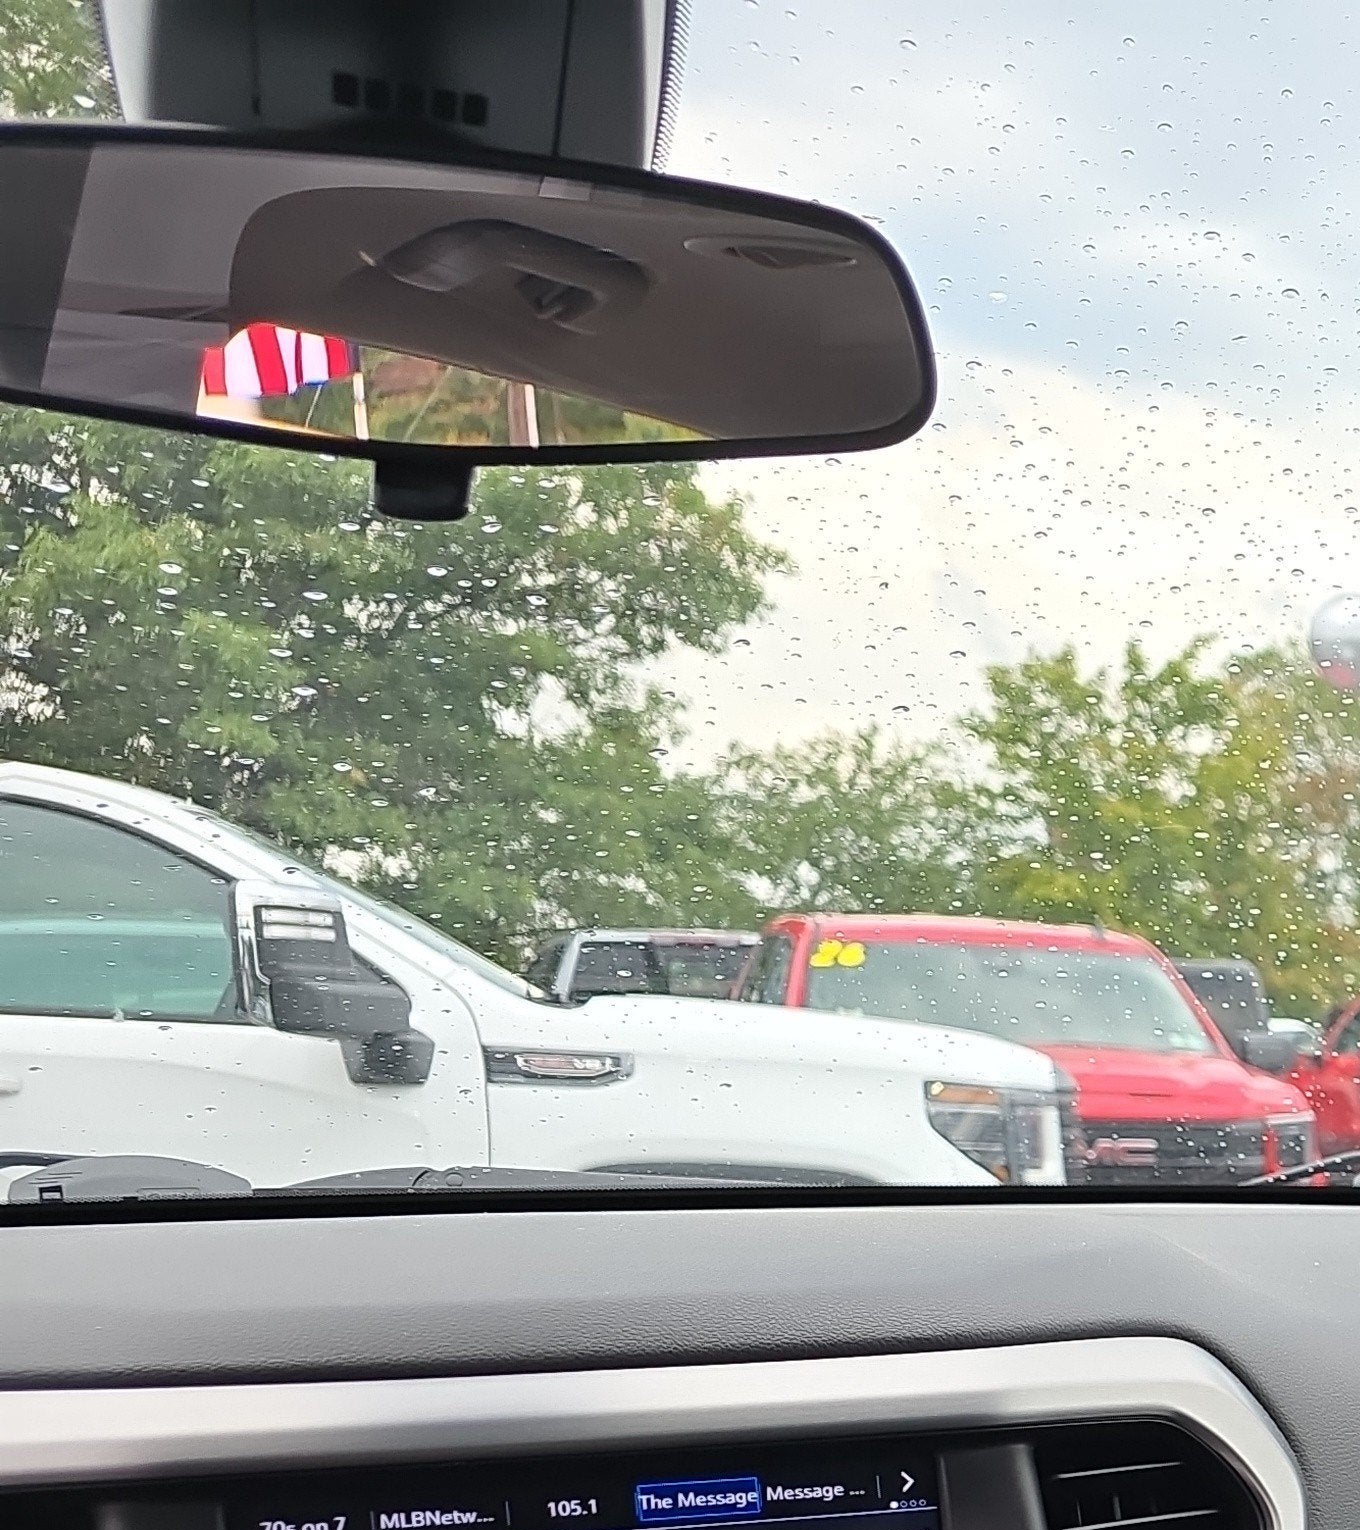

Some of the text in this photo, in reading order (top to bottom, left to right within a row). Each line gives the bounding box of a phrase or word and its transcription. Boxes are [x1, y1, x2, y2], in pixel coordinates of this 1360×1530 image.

[639, 1490, 759, 1511] The Message
[766, 1484, 845, 1502] Message
[547, 1499, 598, 1518] 105.1
